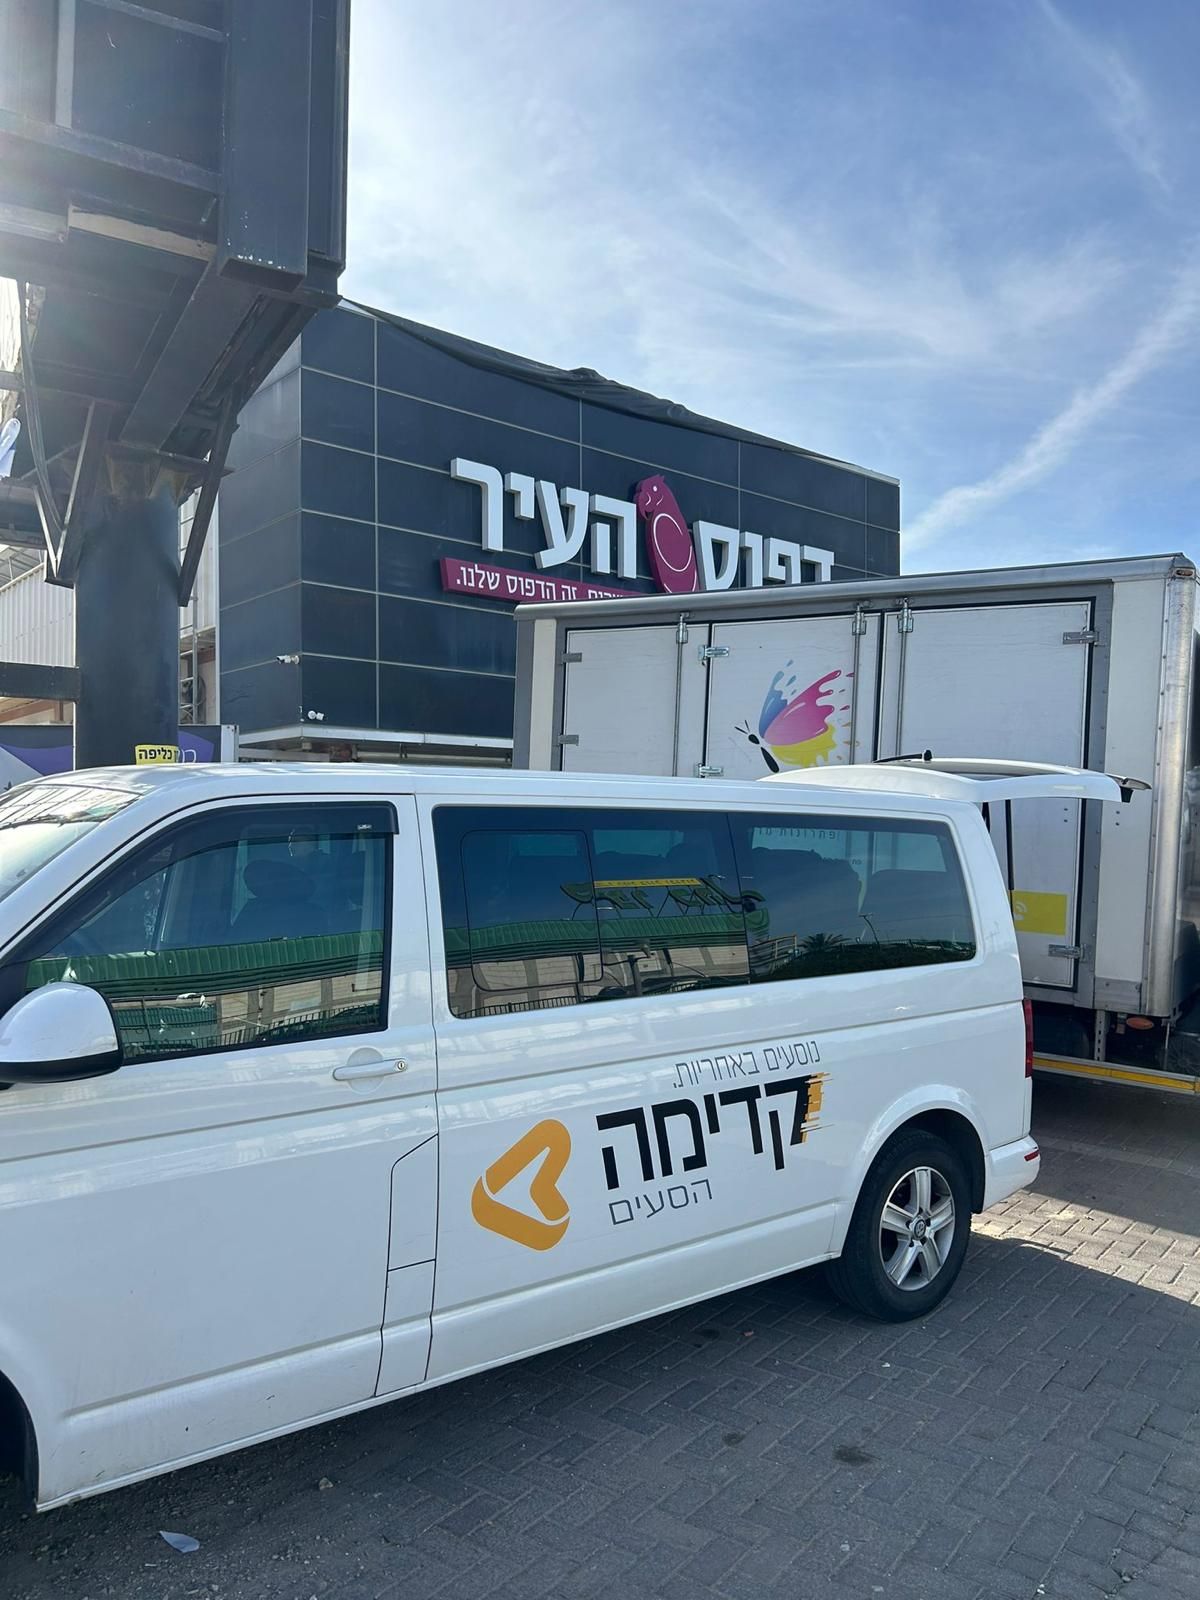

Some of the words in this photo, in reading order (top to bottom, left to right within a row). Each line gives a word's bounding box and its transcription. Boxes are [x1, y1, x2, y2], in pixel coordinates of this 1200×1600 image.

[451, 456, 637, 579] העיר
[694, 520, 834, 590] דפוס
[456, 563, 500, 590] שלנו.
[505, 575, 556, 601] הדפוס
[561, 584, 577, 601] זה
[764, 1040, 821, 1071] נוסעים
[595, 1073, 829, 1190] קדימה
[608, 1178, 713, 1226] הסעים
